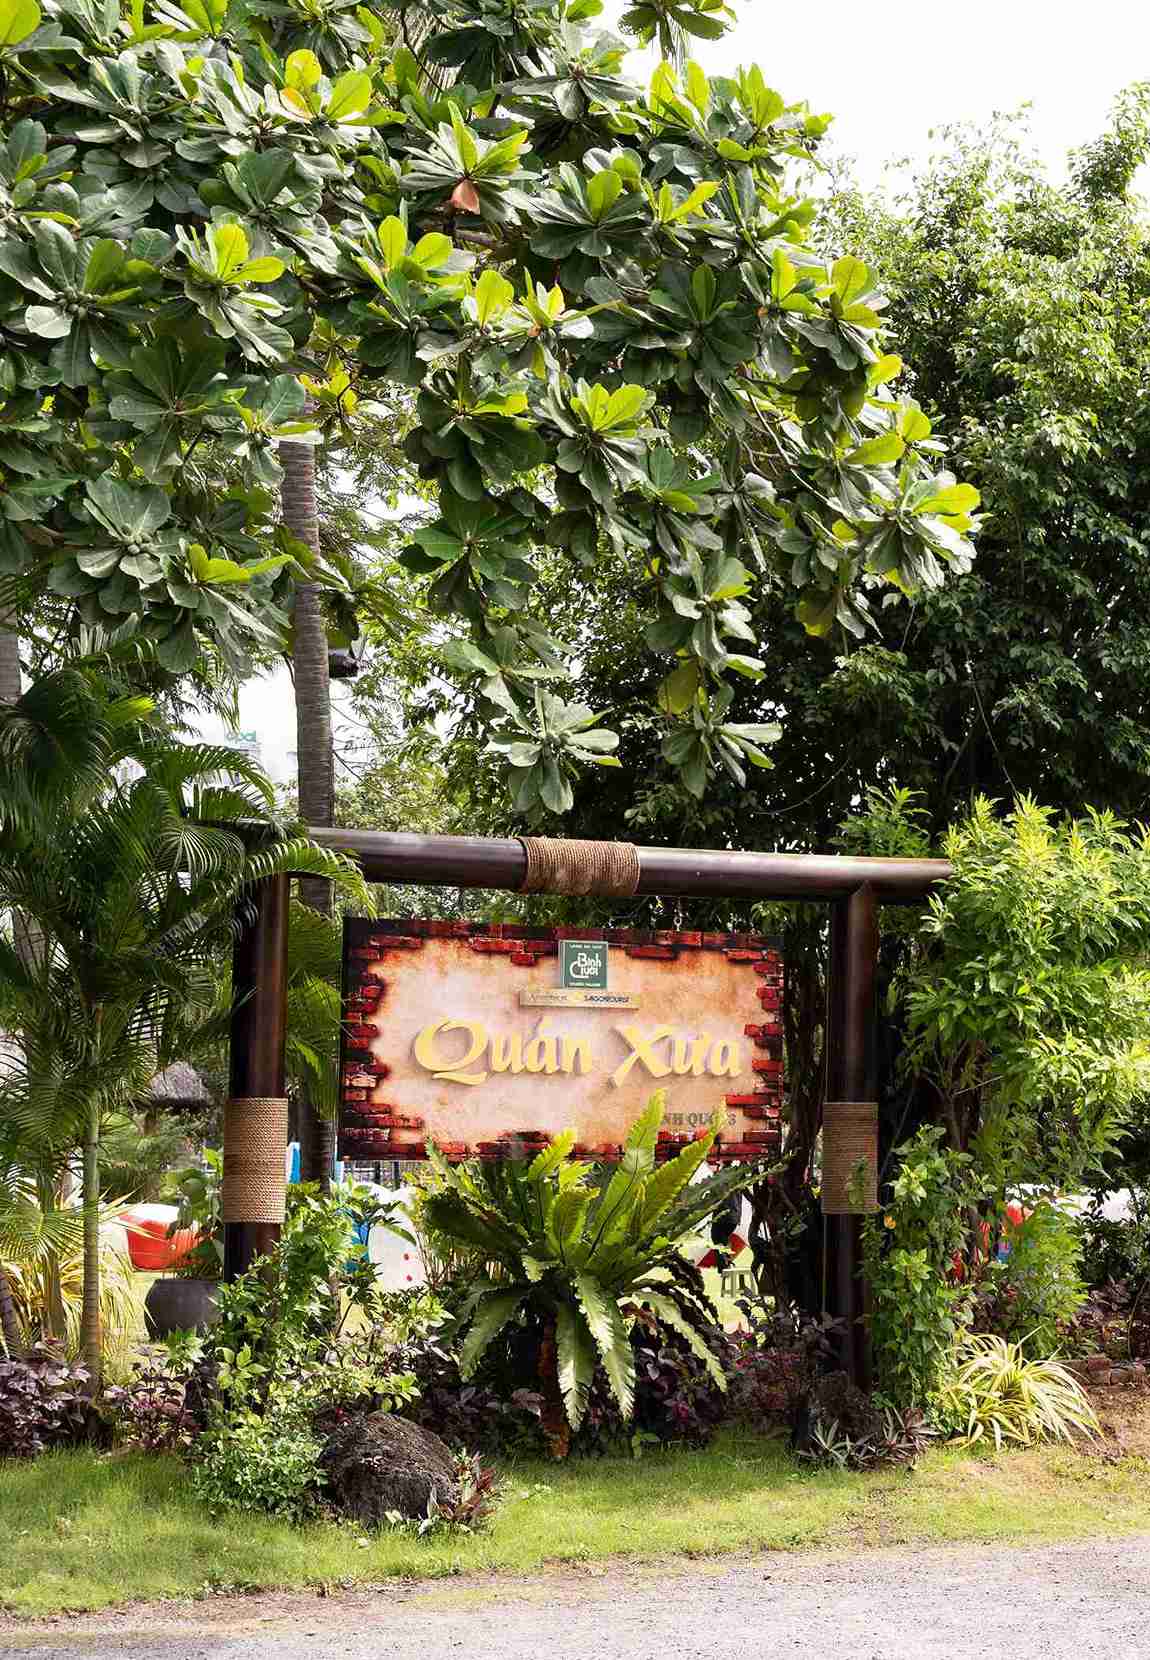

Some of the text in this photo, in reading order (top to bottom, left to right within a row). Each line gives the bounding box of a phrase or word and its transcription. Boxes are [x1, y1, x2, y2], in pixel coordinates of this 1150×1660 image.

[413, 1015, 744, 1089] Quán Xưa
[654, 1112, 685, 1126] NH
